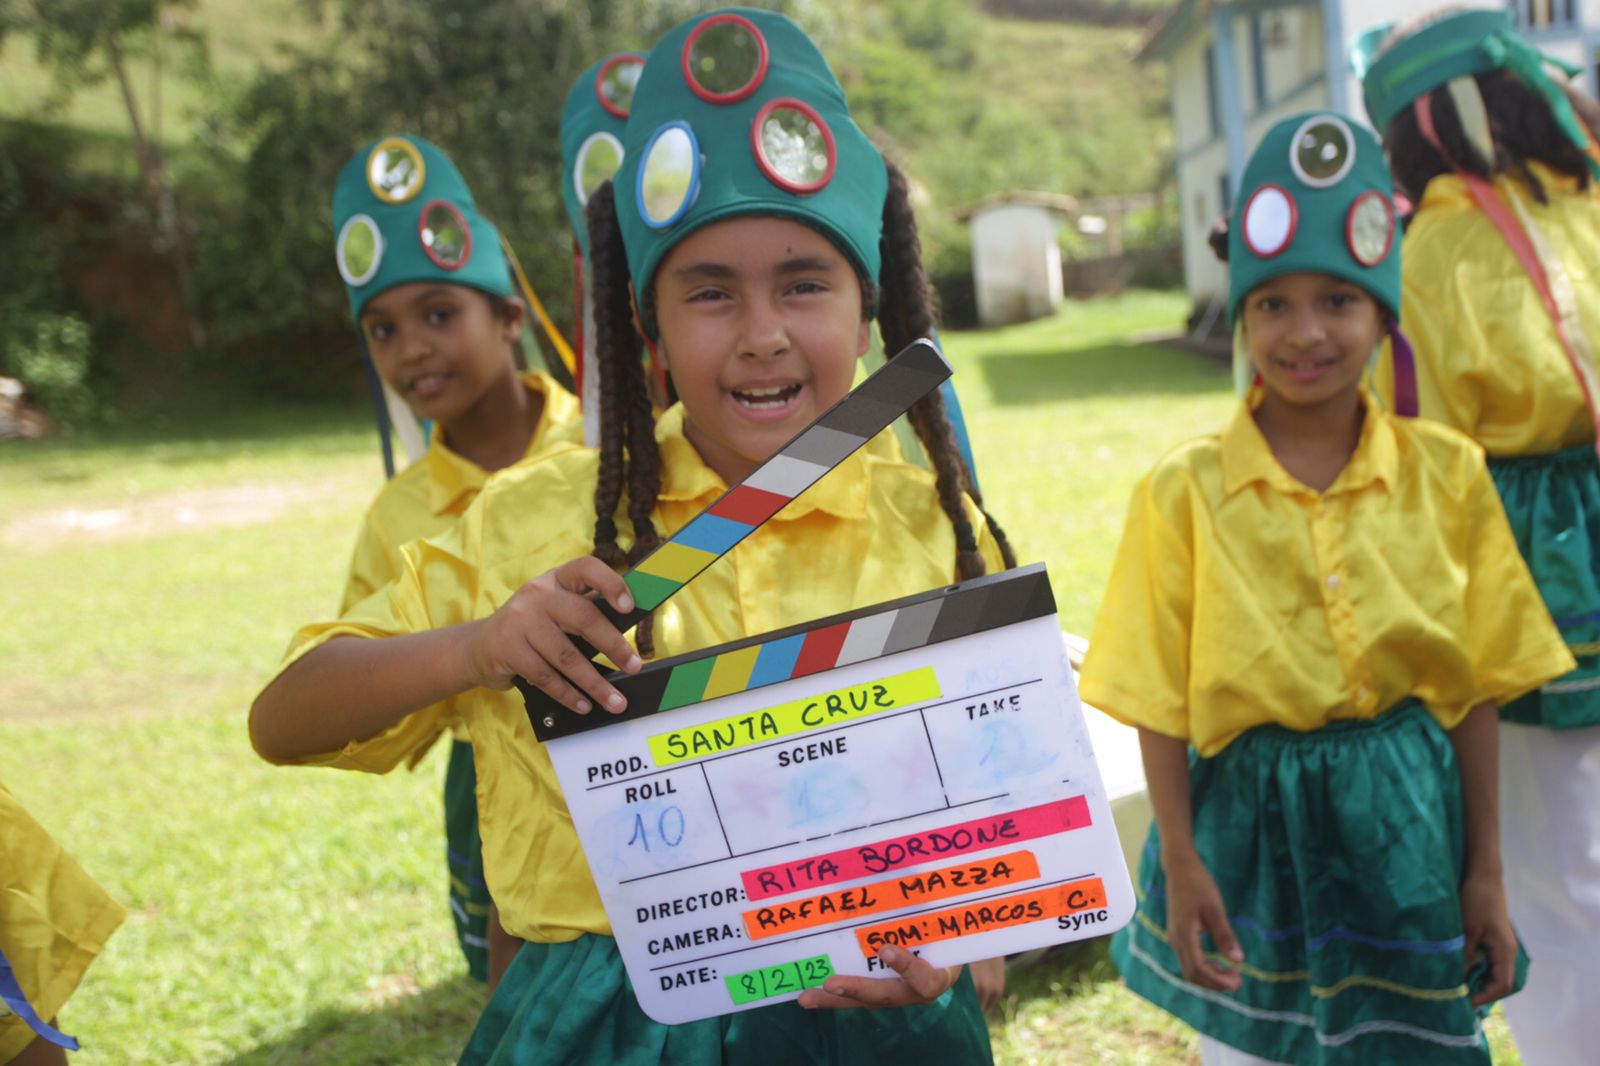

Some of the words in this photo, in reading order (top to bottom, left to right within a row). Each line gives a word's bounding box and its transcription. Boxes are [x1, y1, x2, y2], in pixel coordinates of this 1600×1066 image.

[667, 712, 778, 758] SANTA
[801, 684, 895, 726] CRUZ
[965, 694, 1021, 721] TAKE
[778, 737, 847, 767] SCENE
[587, 756, 649, 783] PROD.
[625, 778, 677, 804] ROLL
[627, 805, 685, 852] 10
[757, 859, 839, 893] RITA
[858, 818, 1020, 873] BORDONE
[636, 887, 746, 924] DIRECTOR:
[756, 887, 877, 930] RAFAEL
[899, 861, 1014, 900] MAZZA
[937, 900, 1043, 936] MARCOS
[1067, 889, 1096, 910] C.
[1057, 909, 1108, 932] Sync
[647, 924, 741, 956] CAMERA:
[660, 967, 718, 992] DATE:
